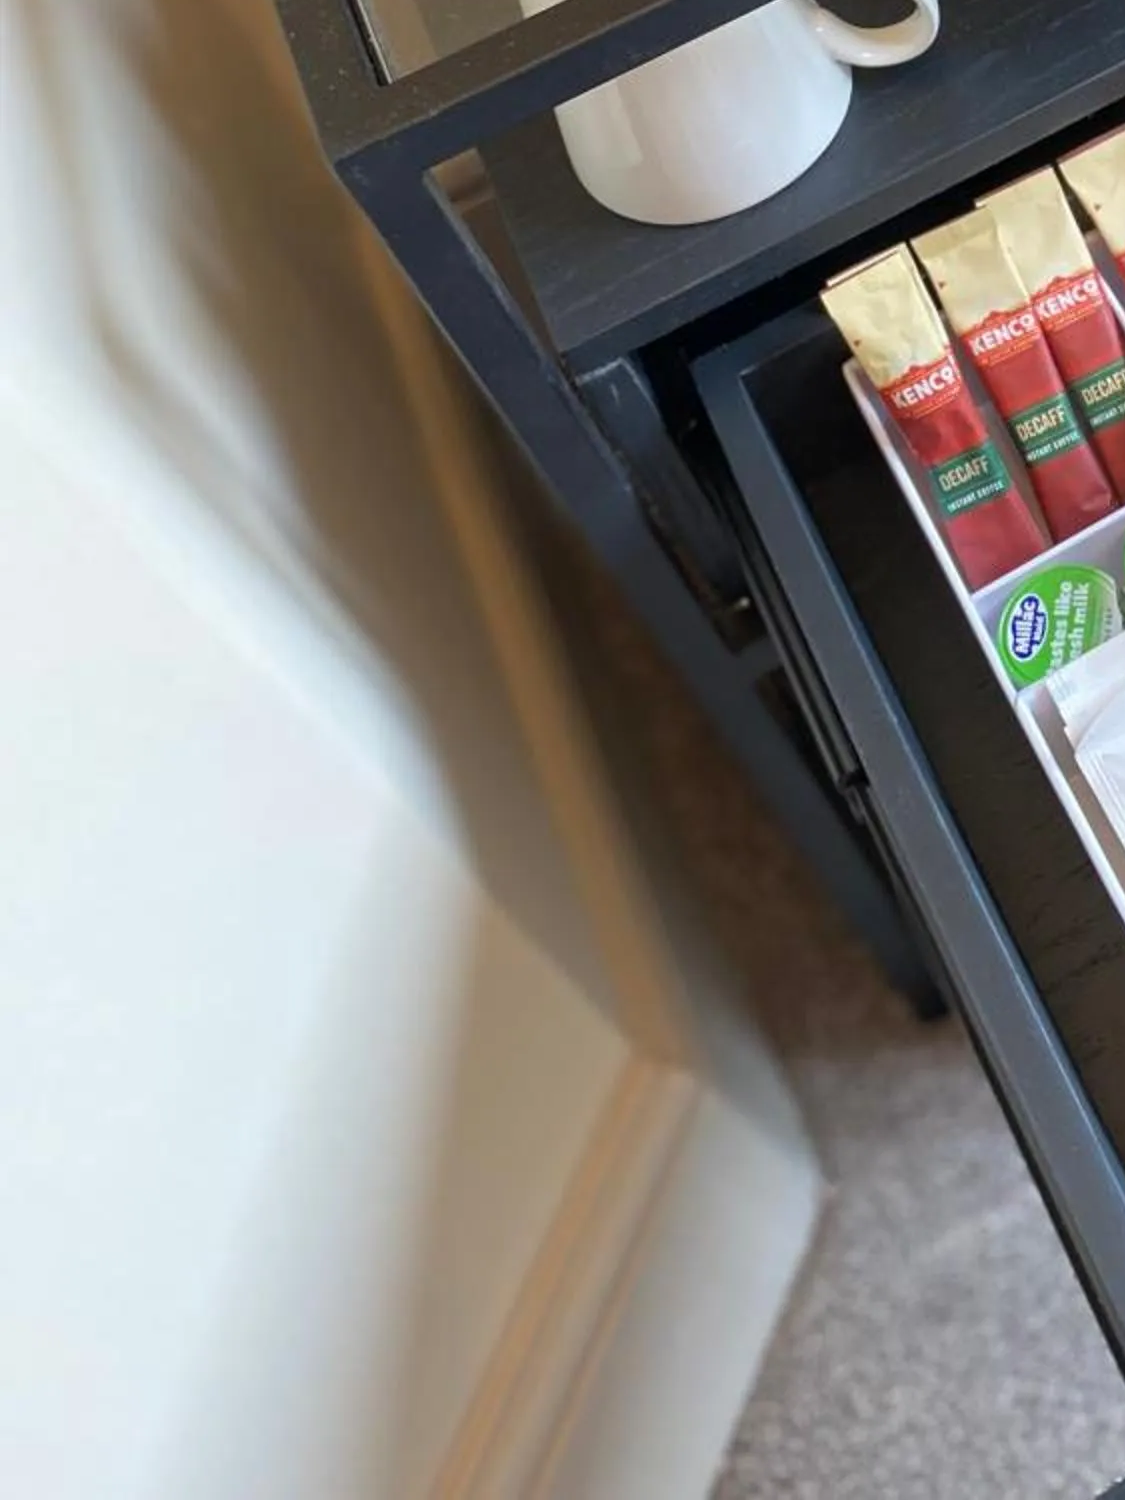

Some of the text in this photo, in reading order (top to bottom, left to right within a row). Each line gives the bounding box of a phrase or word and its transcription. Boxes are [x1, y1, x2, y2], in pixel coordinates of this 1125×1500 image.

[1034, 279, 1100, 321] KENCO
[968, 313, 1036, 357] KENCO
[889, 363, 957, 409] KENCO
[1015, 406, 1067, 442] DECAFF
[937, 454, 991, 492] DECAFF
[1054, 580, 1073, 615] like
[1073, 582, 1089, 624] milk
[1014, 601, 1037, 654] Millac
